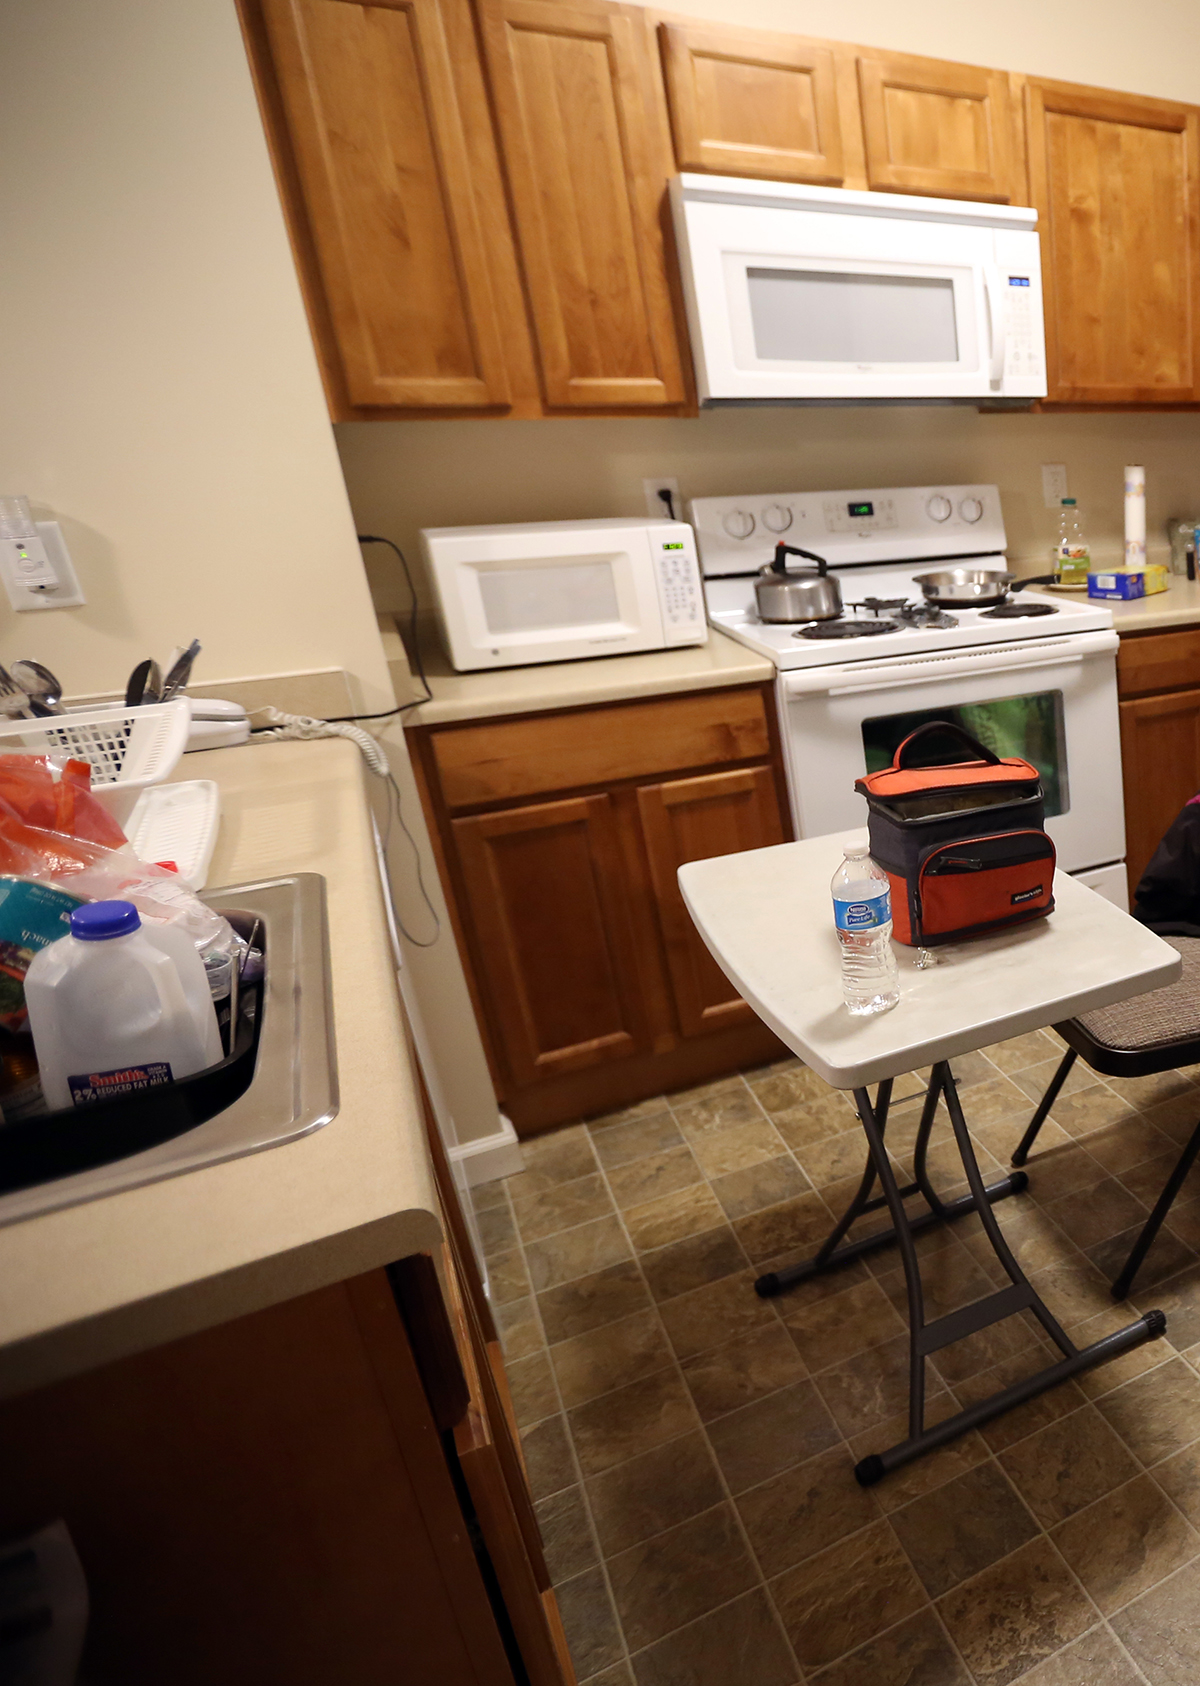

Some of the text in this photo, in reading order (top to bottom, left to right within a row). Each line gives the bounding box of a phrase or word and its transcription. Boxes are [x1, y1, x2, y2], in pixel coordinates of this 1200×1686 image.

[73, 1076, 169, 1101] 2% REDUCED FAT MILK
[89, 1068, 149, 1088] Smith's
